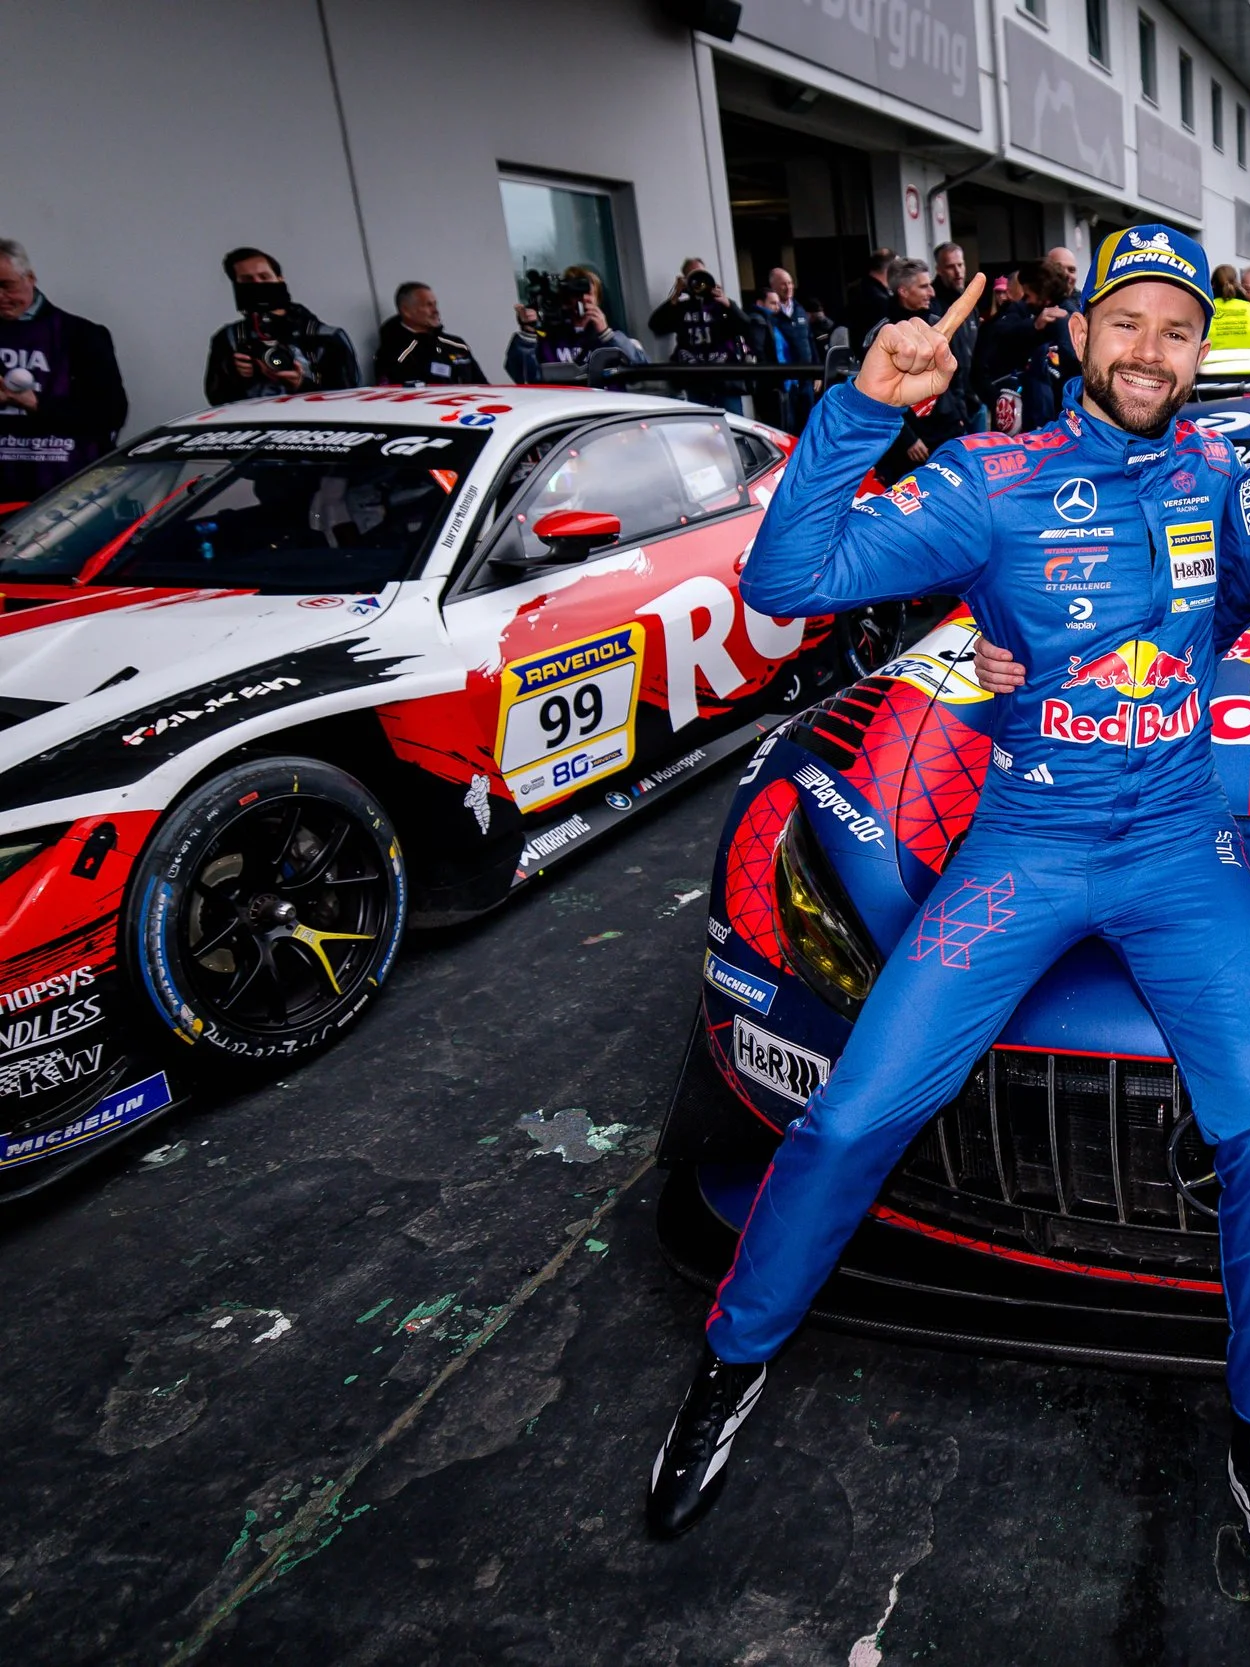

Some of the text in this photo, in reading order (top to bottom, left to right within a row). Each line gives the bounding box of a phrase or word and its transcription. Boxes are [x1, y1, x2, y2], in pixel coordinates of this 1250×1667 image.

[1111, 252, 1196, 278] MICHELIN
[925, 462, 963, 488] AMG
[984, 453, 1028, 476] OMP
[1163, 495, 1210, 509] VERSTAPPEN
[1176, 505, 1199, 513] RACING
[1063, 527, 1115, 538] AMG
[1174, 533, 1211, 544] RAVENOL
[1044, 546, 1109, 555] INTERCONTINENTAL
[1045, 581, 1112, 591] GT CHALLENGE
[1174, 562, 1202, 581] H&R
[1065, 620, 1097, 631] viaplay
[525, 641, 626, 685] RAVENOL
[123, 675, 301, 746] FALKEN
[539, 682, 604, 750] 99
[1041, 699, 1132, 748] Red
[1132, 689, 1201, 749] Bull
[552, 753, 589, 788] 80
[651, 748, 707, 783] Motorsport
[810, 772, 861, 822] Player
[715, 969, 767, 1003] MICHELIN
[19, 1043, 104, 1098] KW
[737, 1026, 790, 1089] H&R
[6, 1094, 145, 1158] MICHELIN
